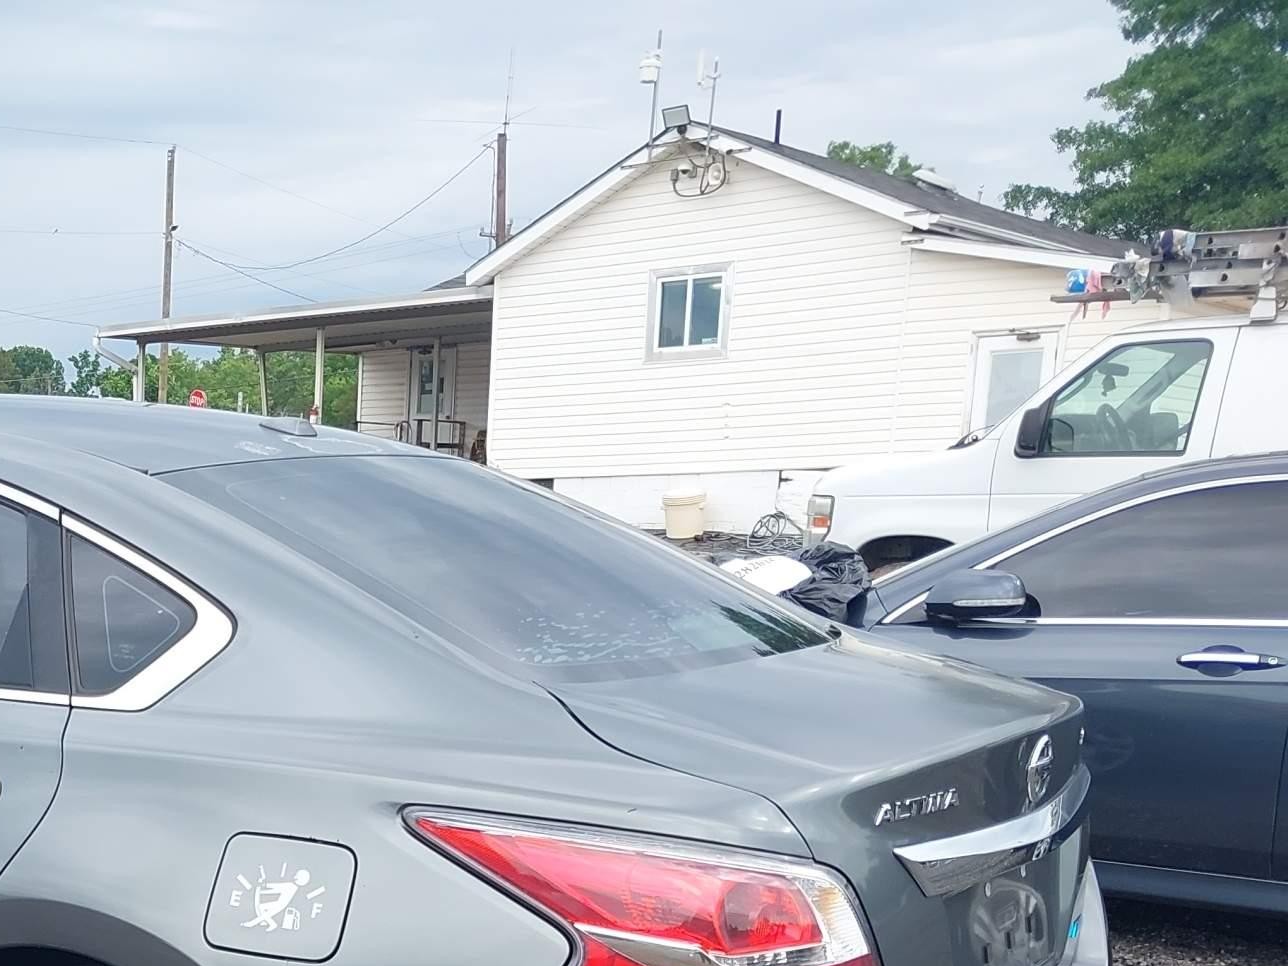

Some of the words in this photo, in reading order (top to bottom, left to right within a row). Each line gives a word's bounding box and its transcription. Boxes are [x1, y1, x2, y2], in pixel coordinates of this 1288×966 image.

[874, 788, 960, 826] ALTIMA
[229, 890, 243, 907] E
[311, 902, 323, 919] F
